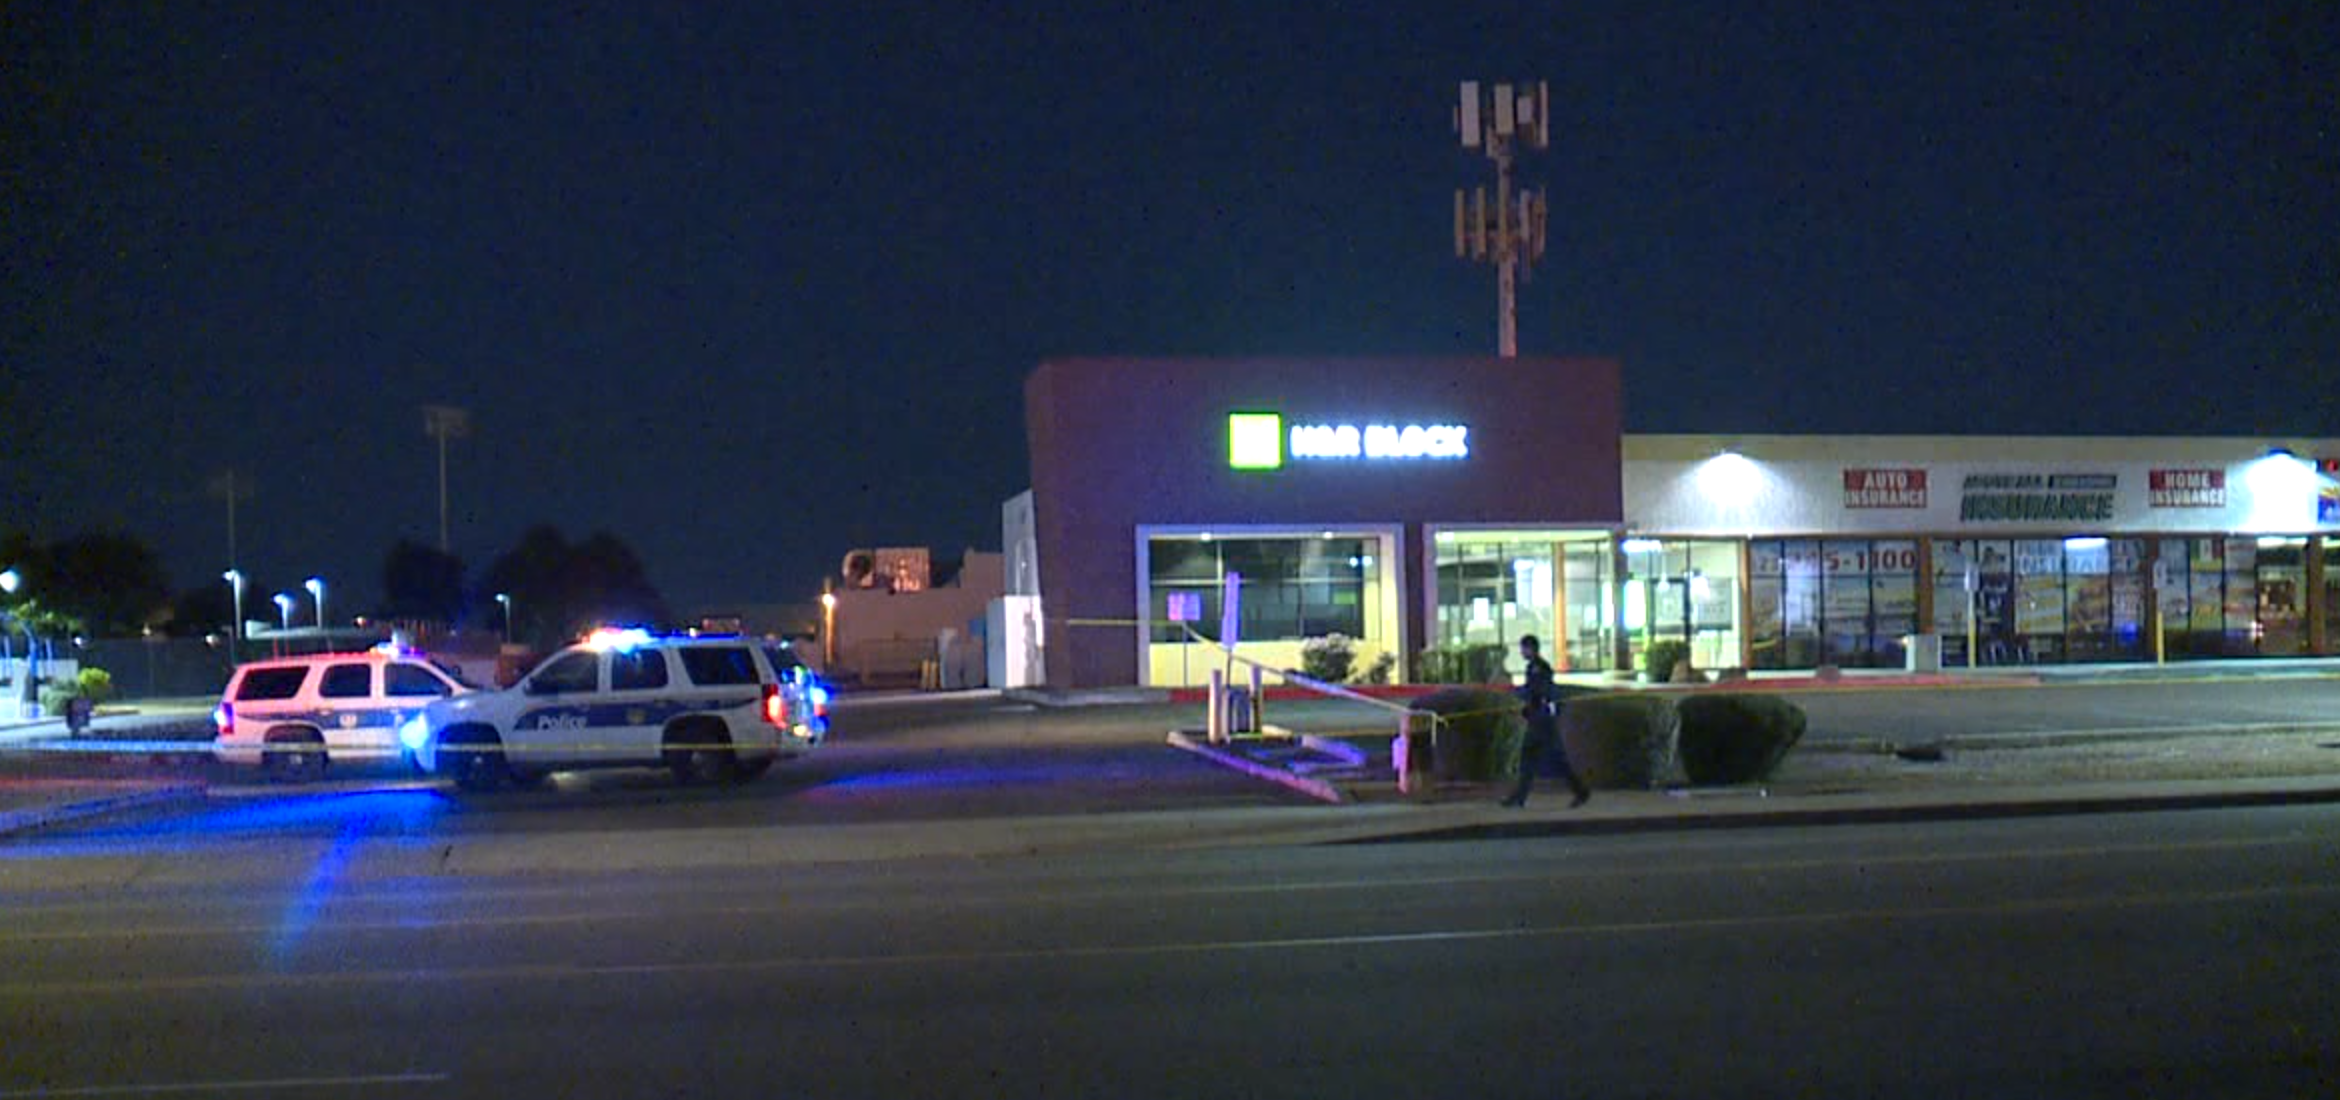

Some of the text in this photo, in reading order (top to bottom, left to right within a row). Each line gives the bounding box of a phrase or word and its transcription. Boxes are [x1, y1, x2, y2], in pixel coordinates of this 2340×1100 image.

[1363, 424, 1468, 459] BLOCK
[1863, 470, 1909, 489] AUTO
[2164, 472, 2211, 489] HOME
[1844, 490, 1926, 506] INSURANCE
[2150, 489, 2224, 505] INSURANCE
[1960, 492, 2115, 523] INSURANCE
[538, 713, 588, 732] Police
